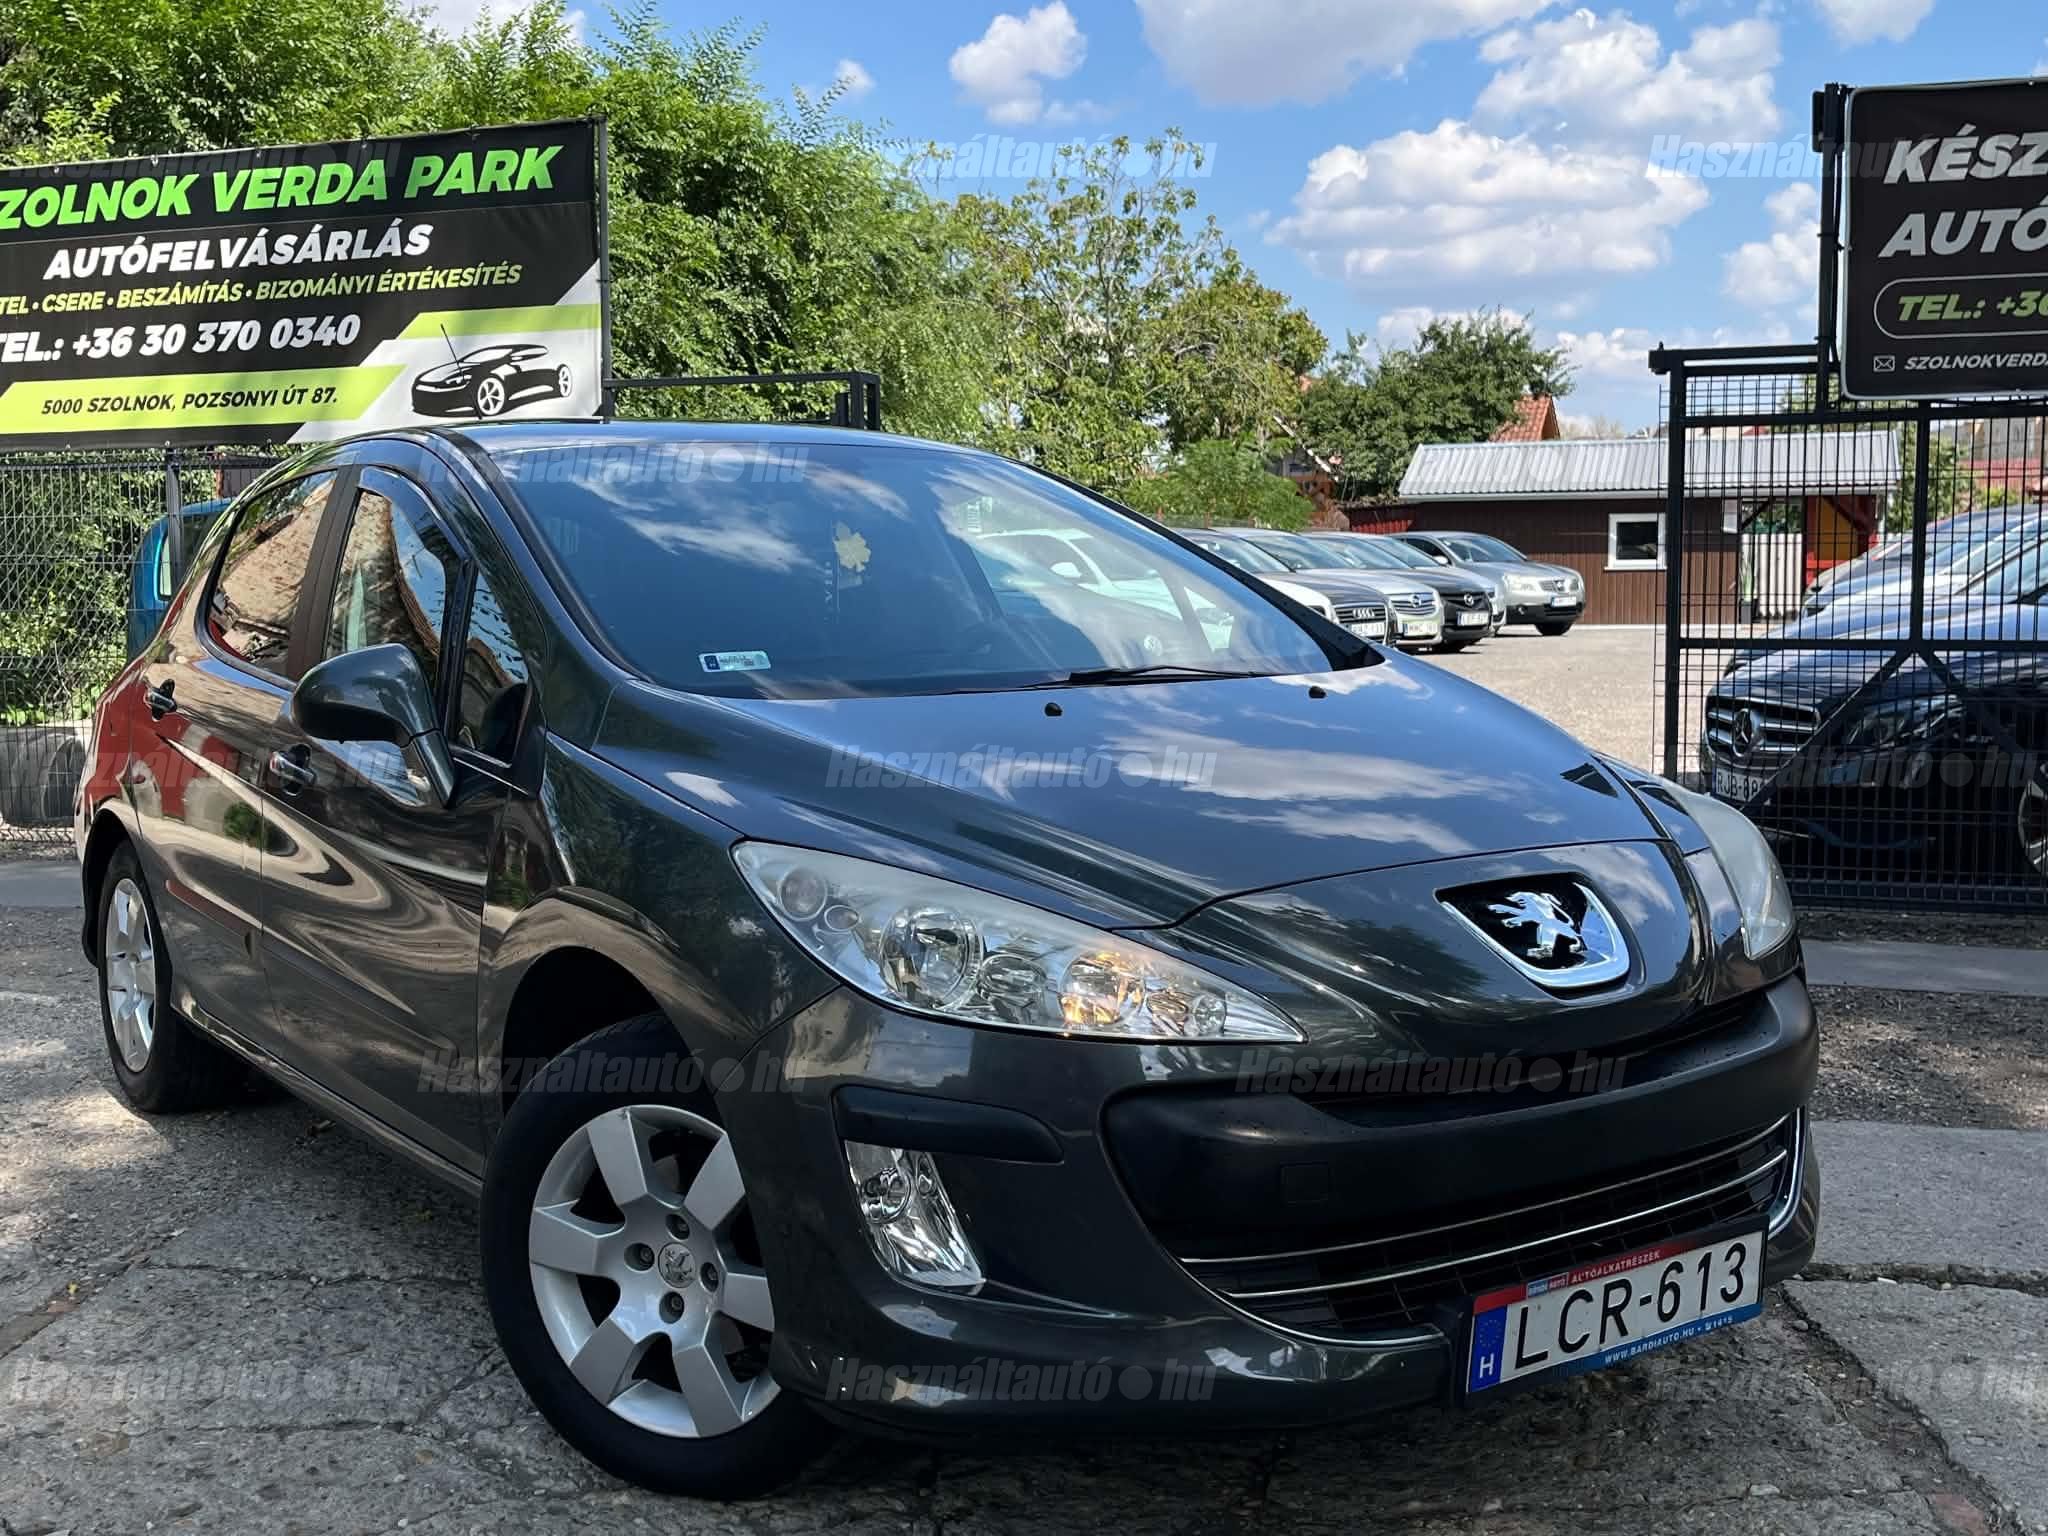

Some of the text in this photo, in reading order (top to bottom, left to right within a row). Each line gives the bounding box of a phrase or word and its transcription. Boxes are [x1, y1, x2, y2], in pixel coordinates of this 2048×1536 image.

[213, 159, 388, 213] VERDA
[403, 146, 564, 198] PARK
[1884, 124, 2048, 185] KÉSZ
[43, 218, 433, 280] AUTÓFELVÁSÁRLÁS
[1878, 195, 2048, 258] AUTÓ
[42, 290, 105, 312] CSERE
[116, 279, 243, 309] BESZÁMÍTÁS
[256, 272, 374, 302] BIZOMÁNYI
[377, 262, 522, 293] ÉRTÉKESÍTÉS
[1898, 294, 1986, 321] TEL.:
[71, 325, 135, 359] +36
[138, 322, 186, 355] 30
[192, 318, 260, 353] 370
[268, 313, 361, 350] 0340
[1904, 352, 2048, 371] SZOLNOKVERD
[41, 384, 338, 415] 5000 SZOLNOK, POZSONYI ÚT 87.
[1515, 1242, 1747, 1369] LCR-613
[1479, 1352, 1494, 1379] H
